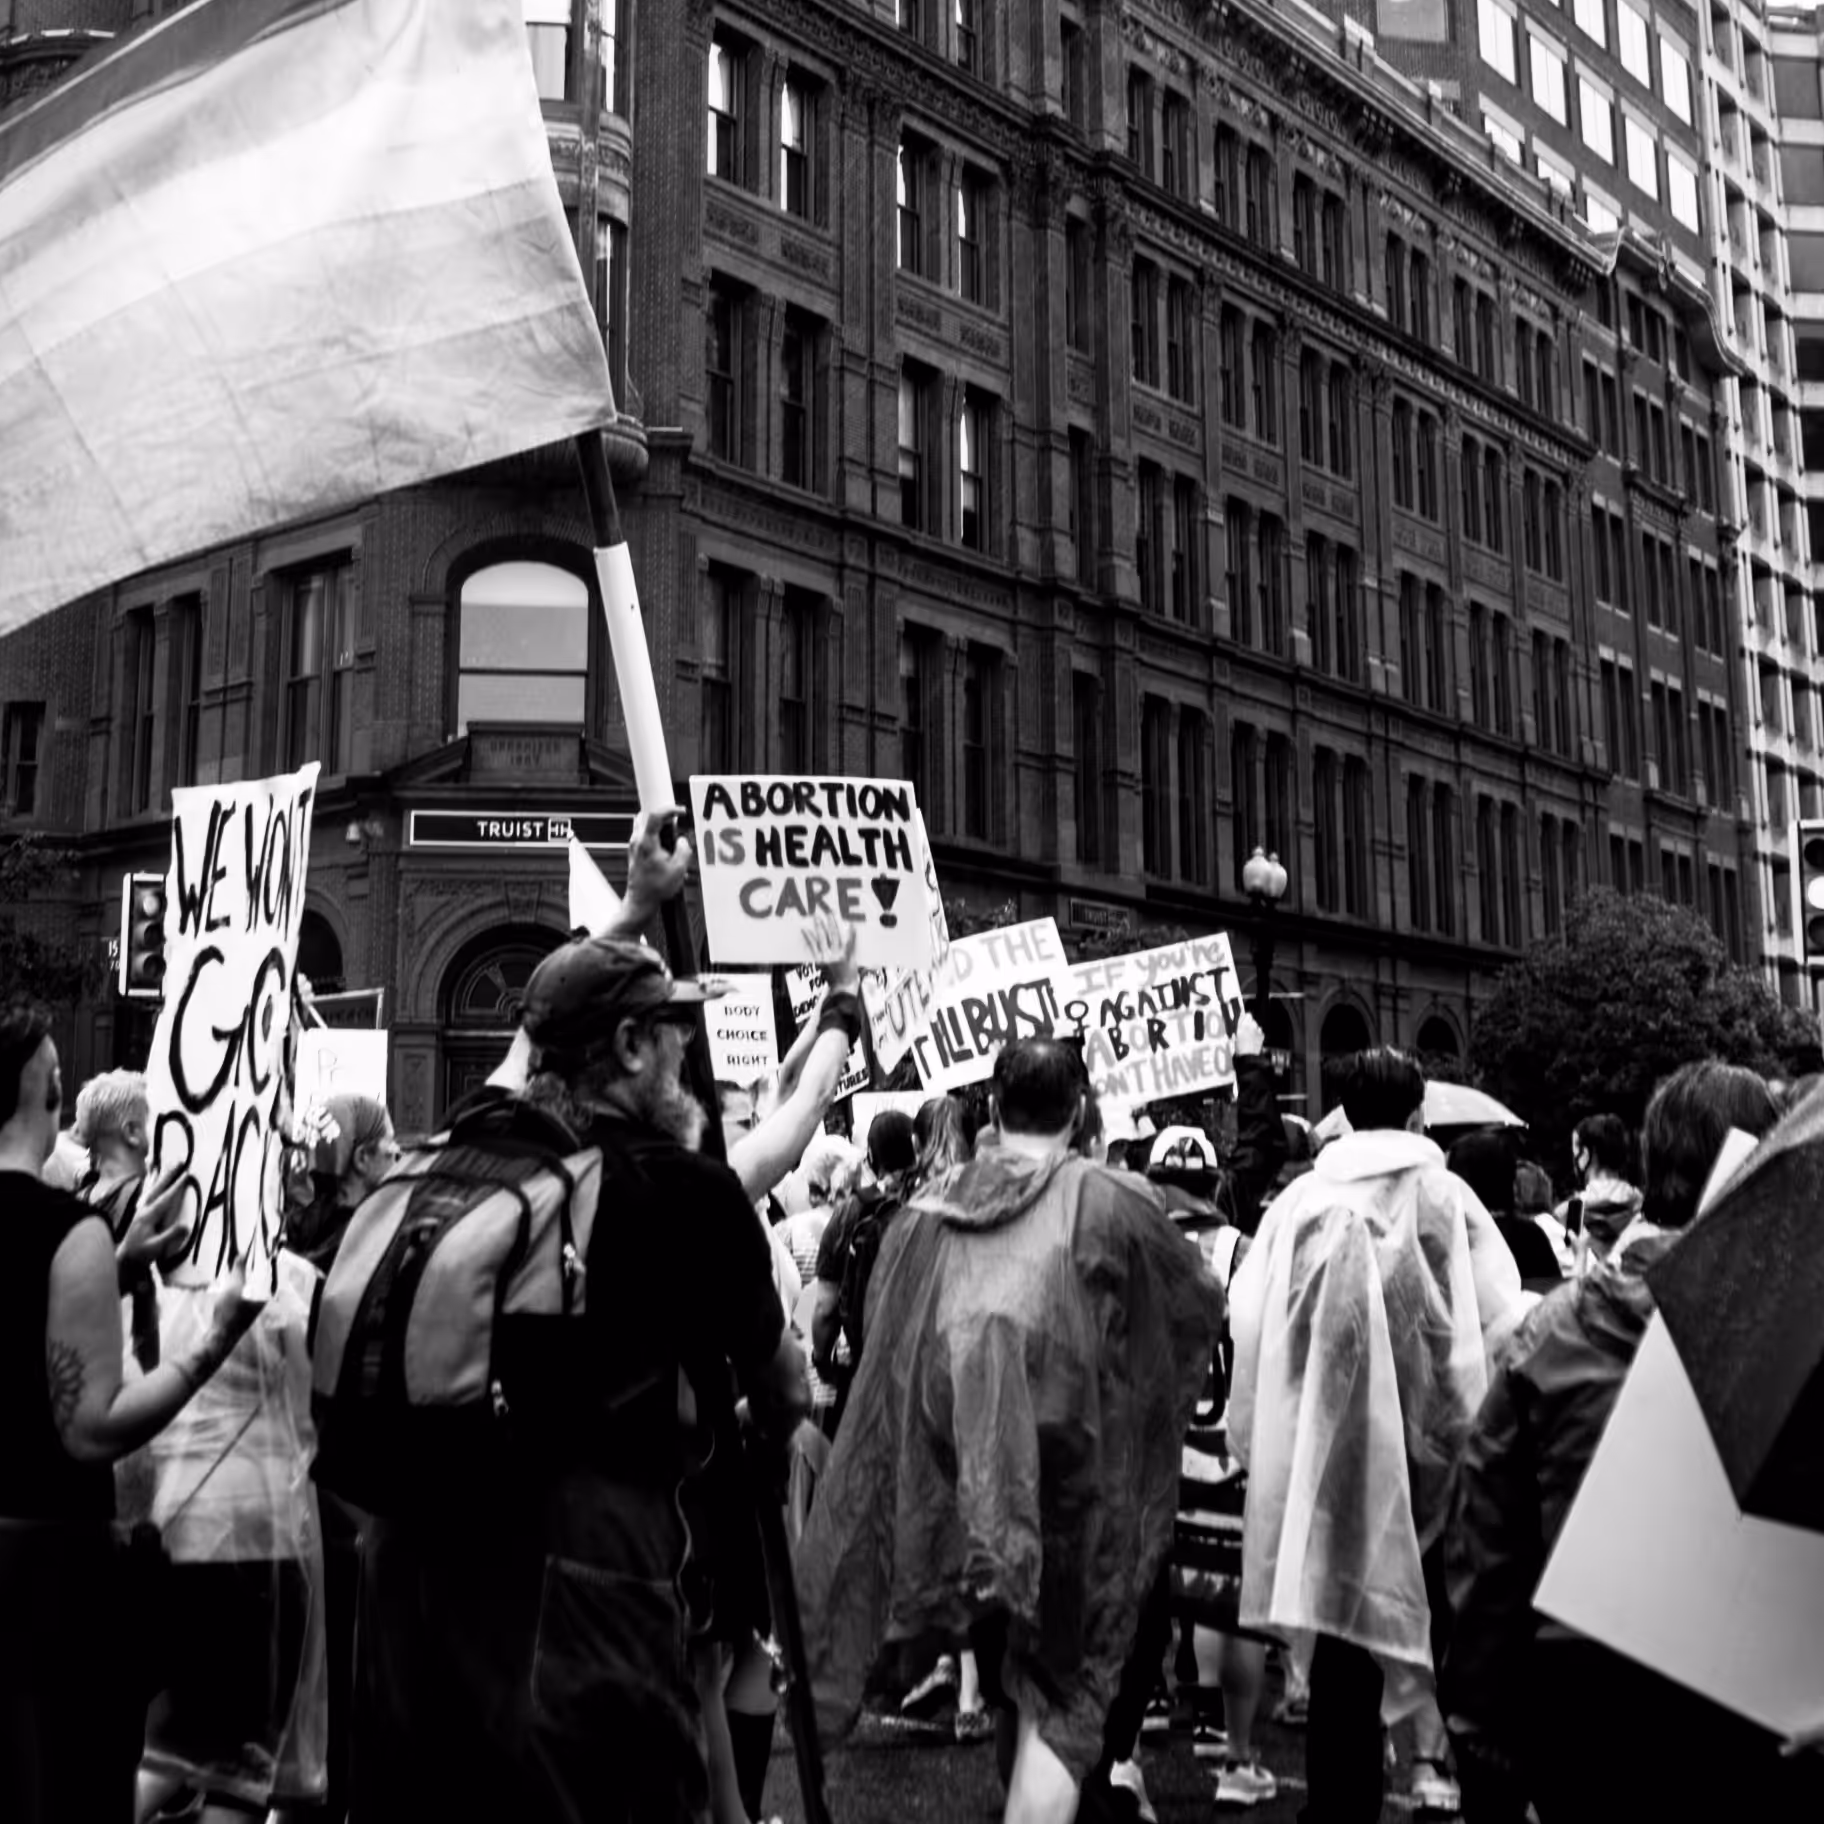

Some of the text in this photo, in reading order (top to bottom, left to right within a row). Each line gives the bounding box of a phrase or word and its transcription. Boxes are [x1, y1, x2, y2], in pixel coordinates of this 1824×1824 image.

[703, 781, 911, 823] ABORTION
[477, 820, 544, 839] TRUIST
[704, 824, 914, 873] IS HEALTH
[174, 799, 236, 940] WE
[739, 873, 901, 929] CARE!
[979, 923, 1056, 970] THE
[1073, 960, 1125, 996] IF
[1100, 966, 1230, 1028] AGAINST
[169, 944, 286, 1115] GO
[716, 1028, 768, 1042] CHOICE
[724, 1004, 761, 1018] BODY
[1086, 996, 1242, 1073] ABORTION
[726, 1053, 768, 1066] RIGHT
[1090, 1059, 1148, 1097] ON'T
[1150, 1046, 1213, 1093] HAVE
